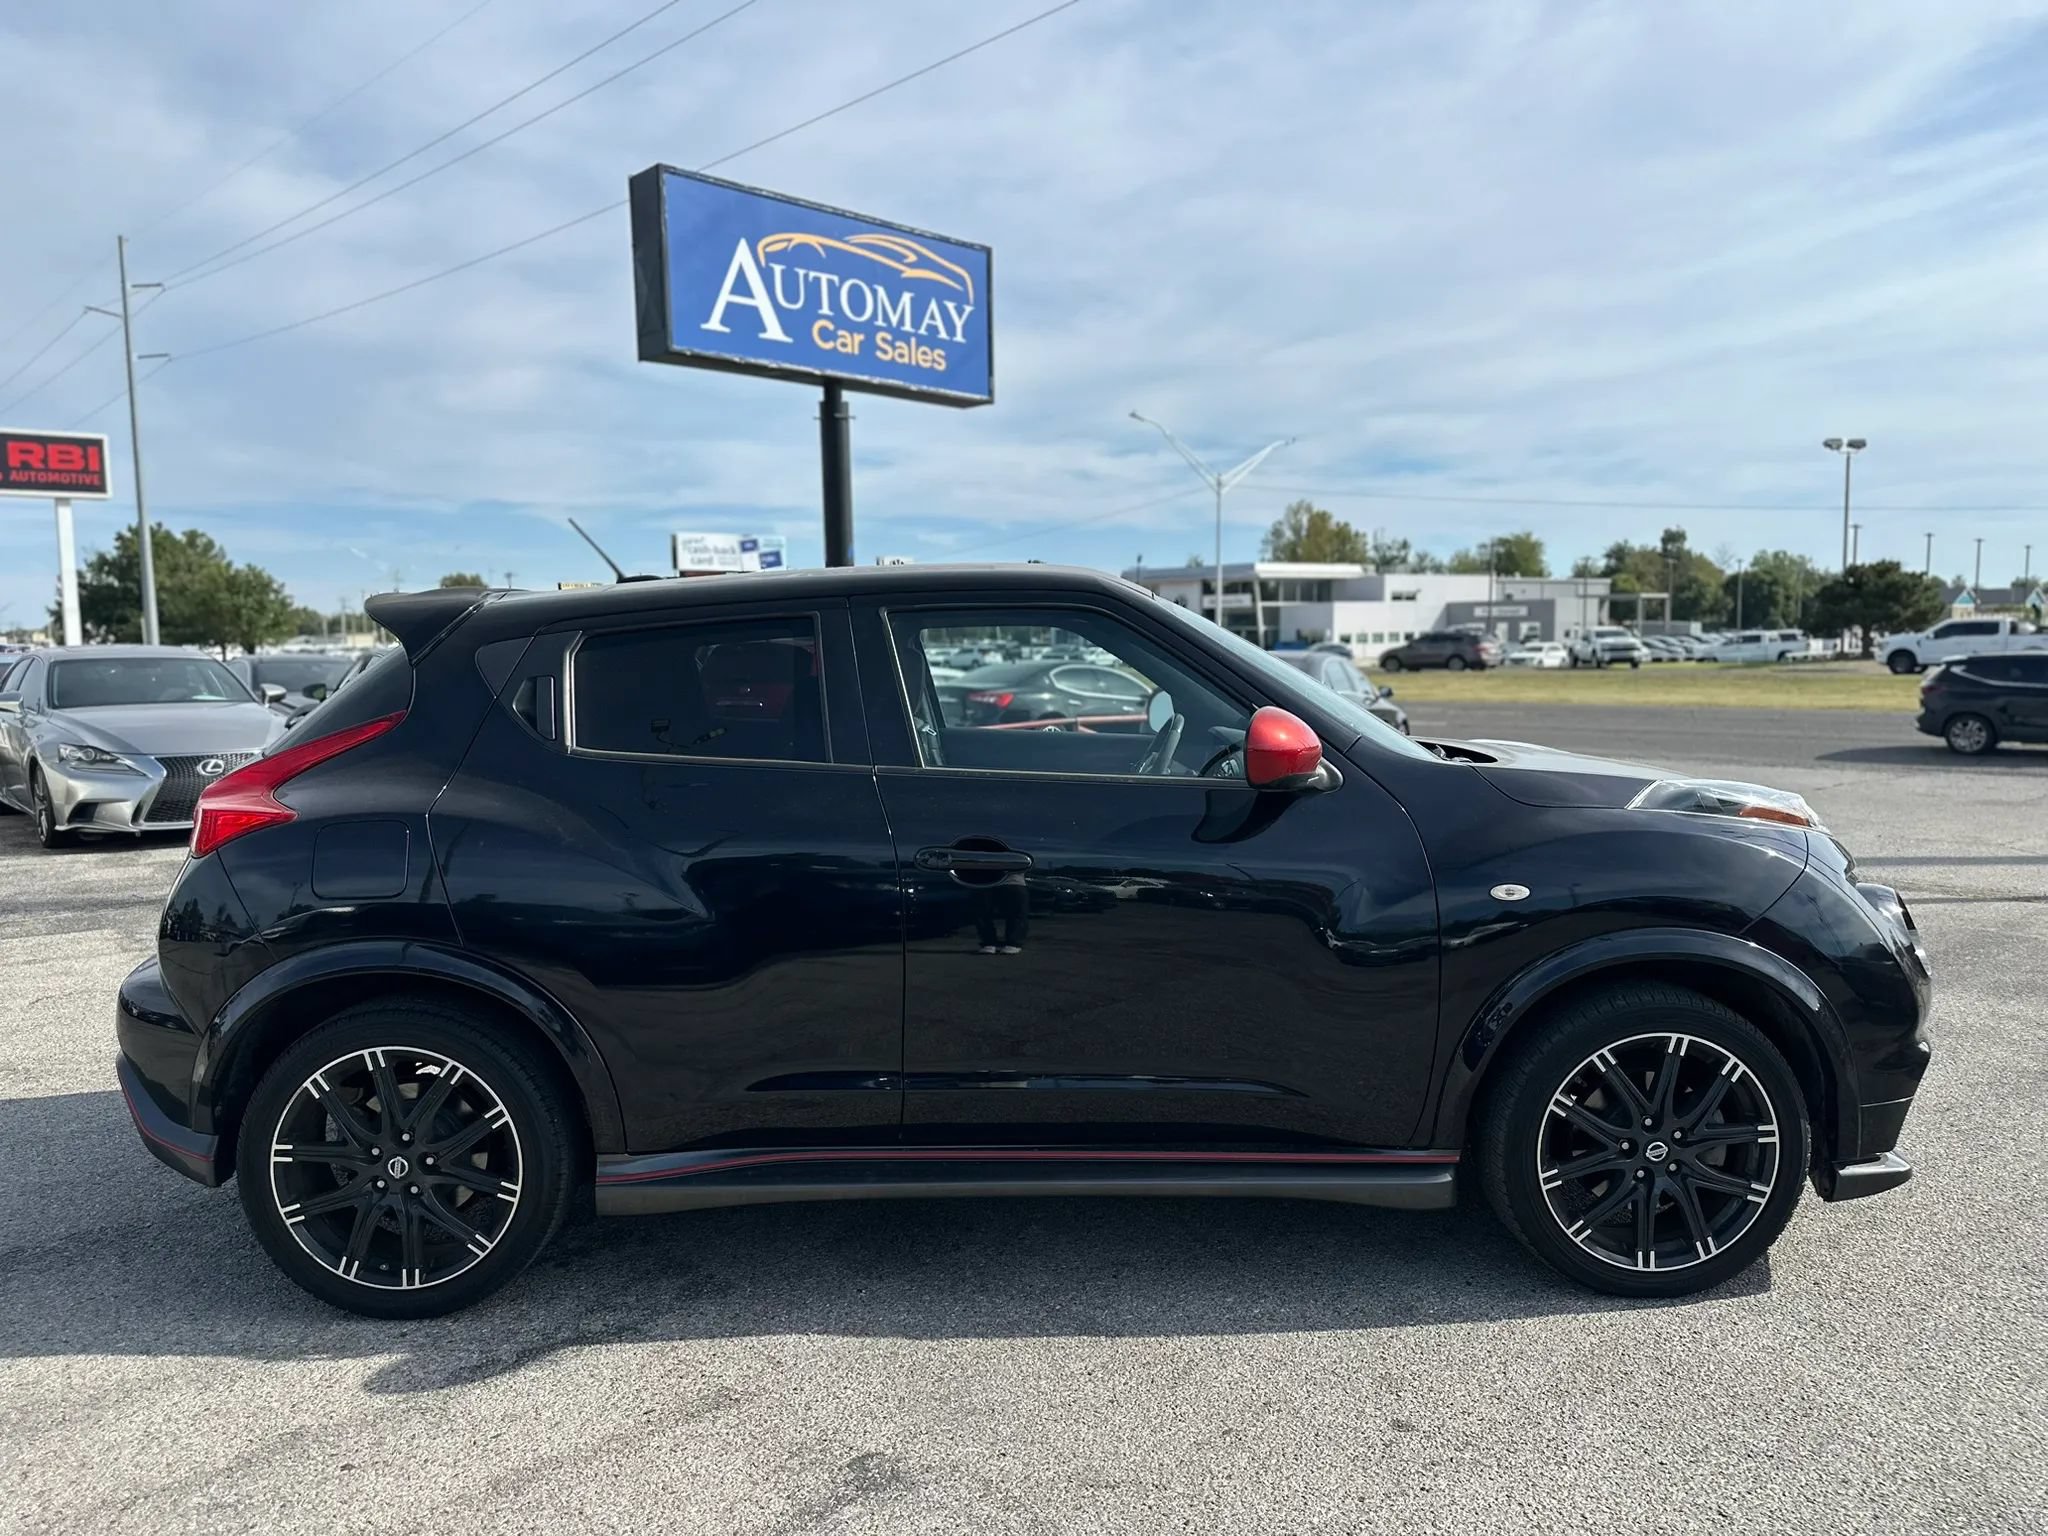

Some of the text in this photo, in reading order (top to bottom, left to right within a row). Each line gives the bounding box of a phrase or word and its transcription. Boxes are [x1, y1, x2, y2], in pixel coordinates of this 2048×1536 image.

[700, 237, 975, 343] AUTOMAY
[811, 319, 947, 372] Car Sales
[7, 440, 101, 472] RBI
[10, 469, 101, 486] AUTOMOTIVE
